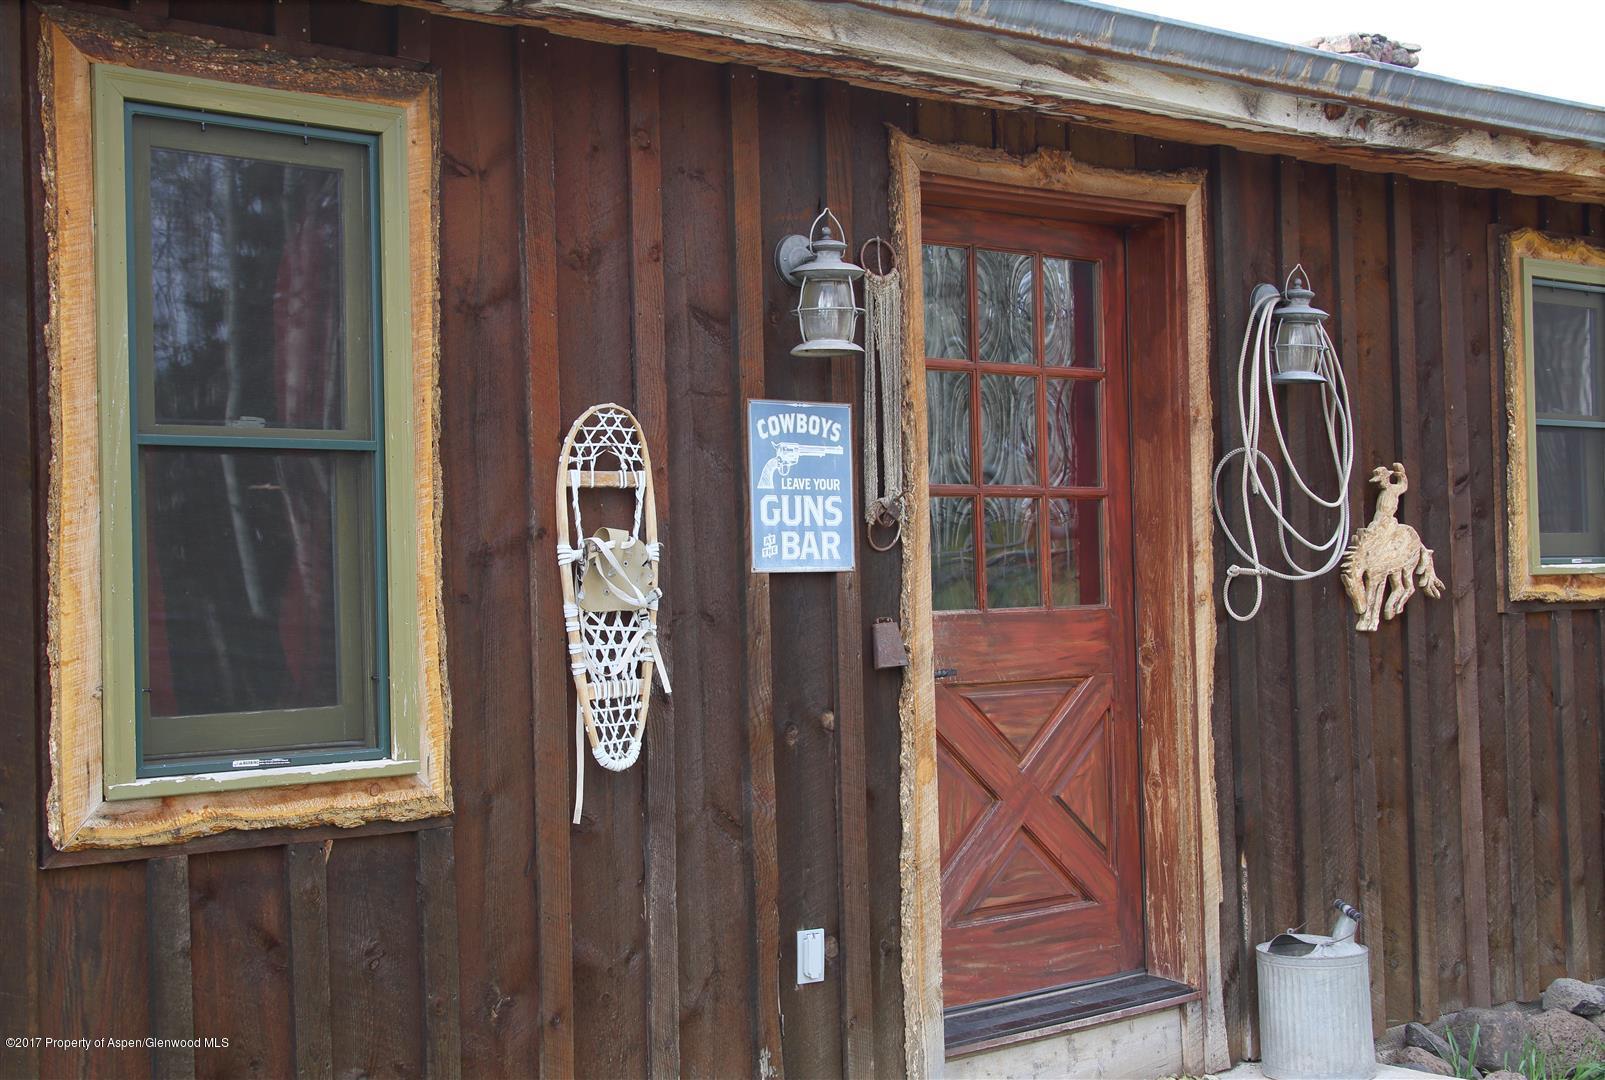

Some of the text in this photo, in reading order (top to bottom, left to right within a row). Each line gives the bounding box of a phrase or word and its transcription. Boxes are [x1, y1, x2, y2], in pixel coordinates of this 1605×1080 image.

[757, 413, 841, 442] COWBOYS
[781, 477, 840, 492] LEAVE YOUR
[760, 494, 843, 527] GUNS
[762, 546, 778, 556] THE
[764, 535, 775, 545] AT
[781, 530, 841, 560] BAR
